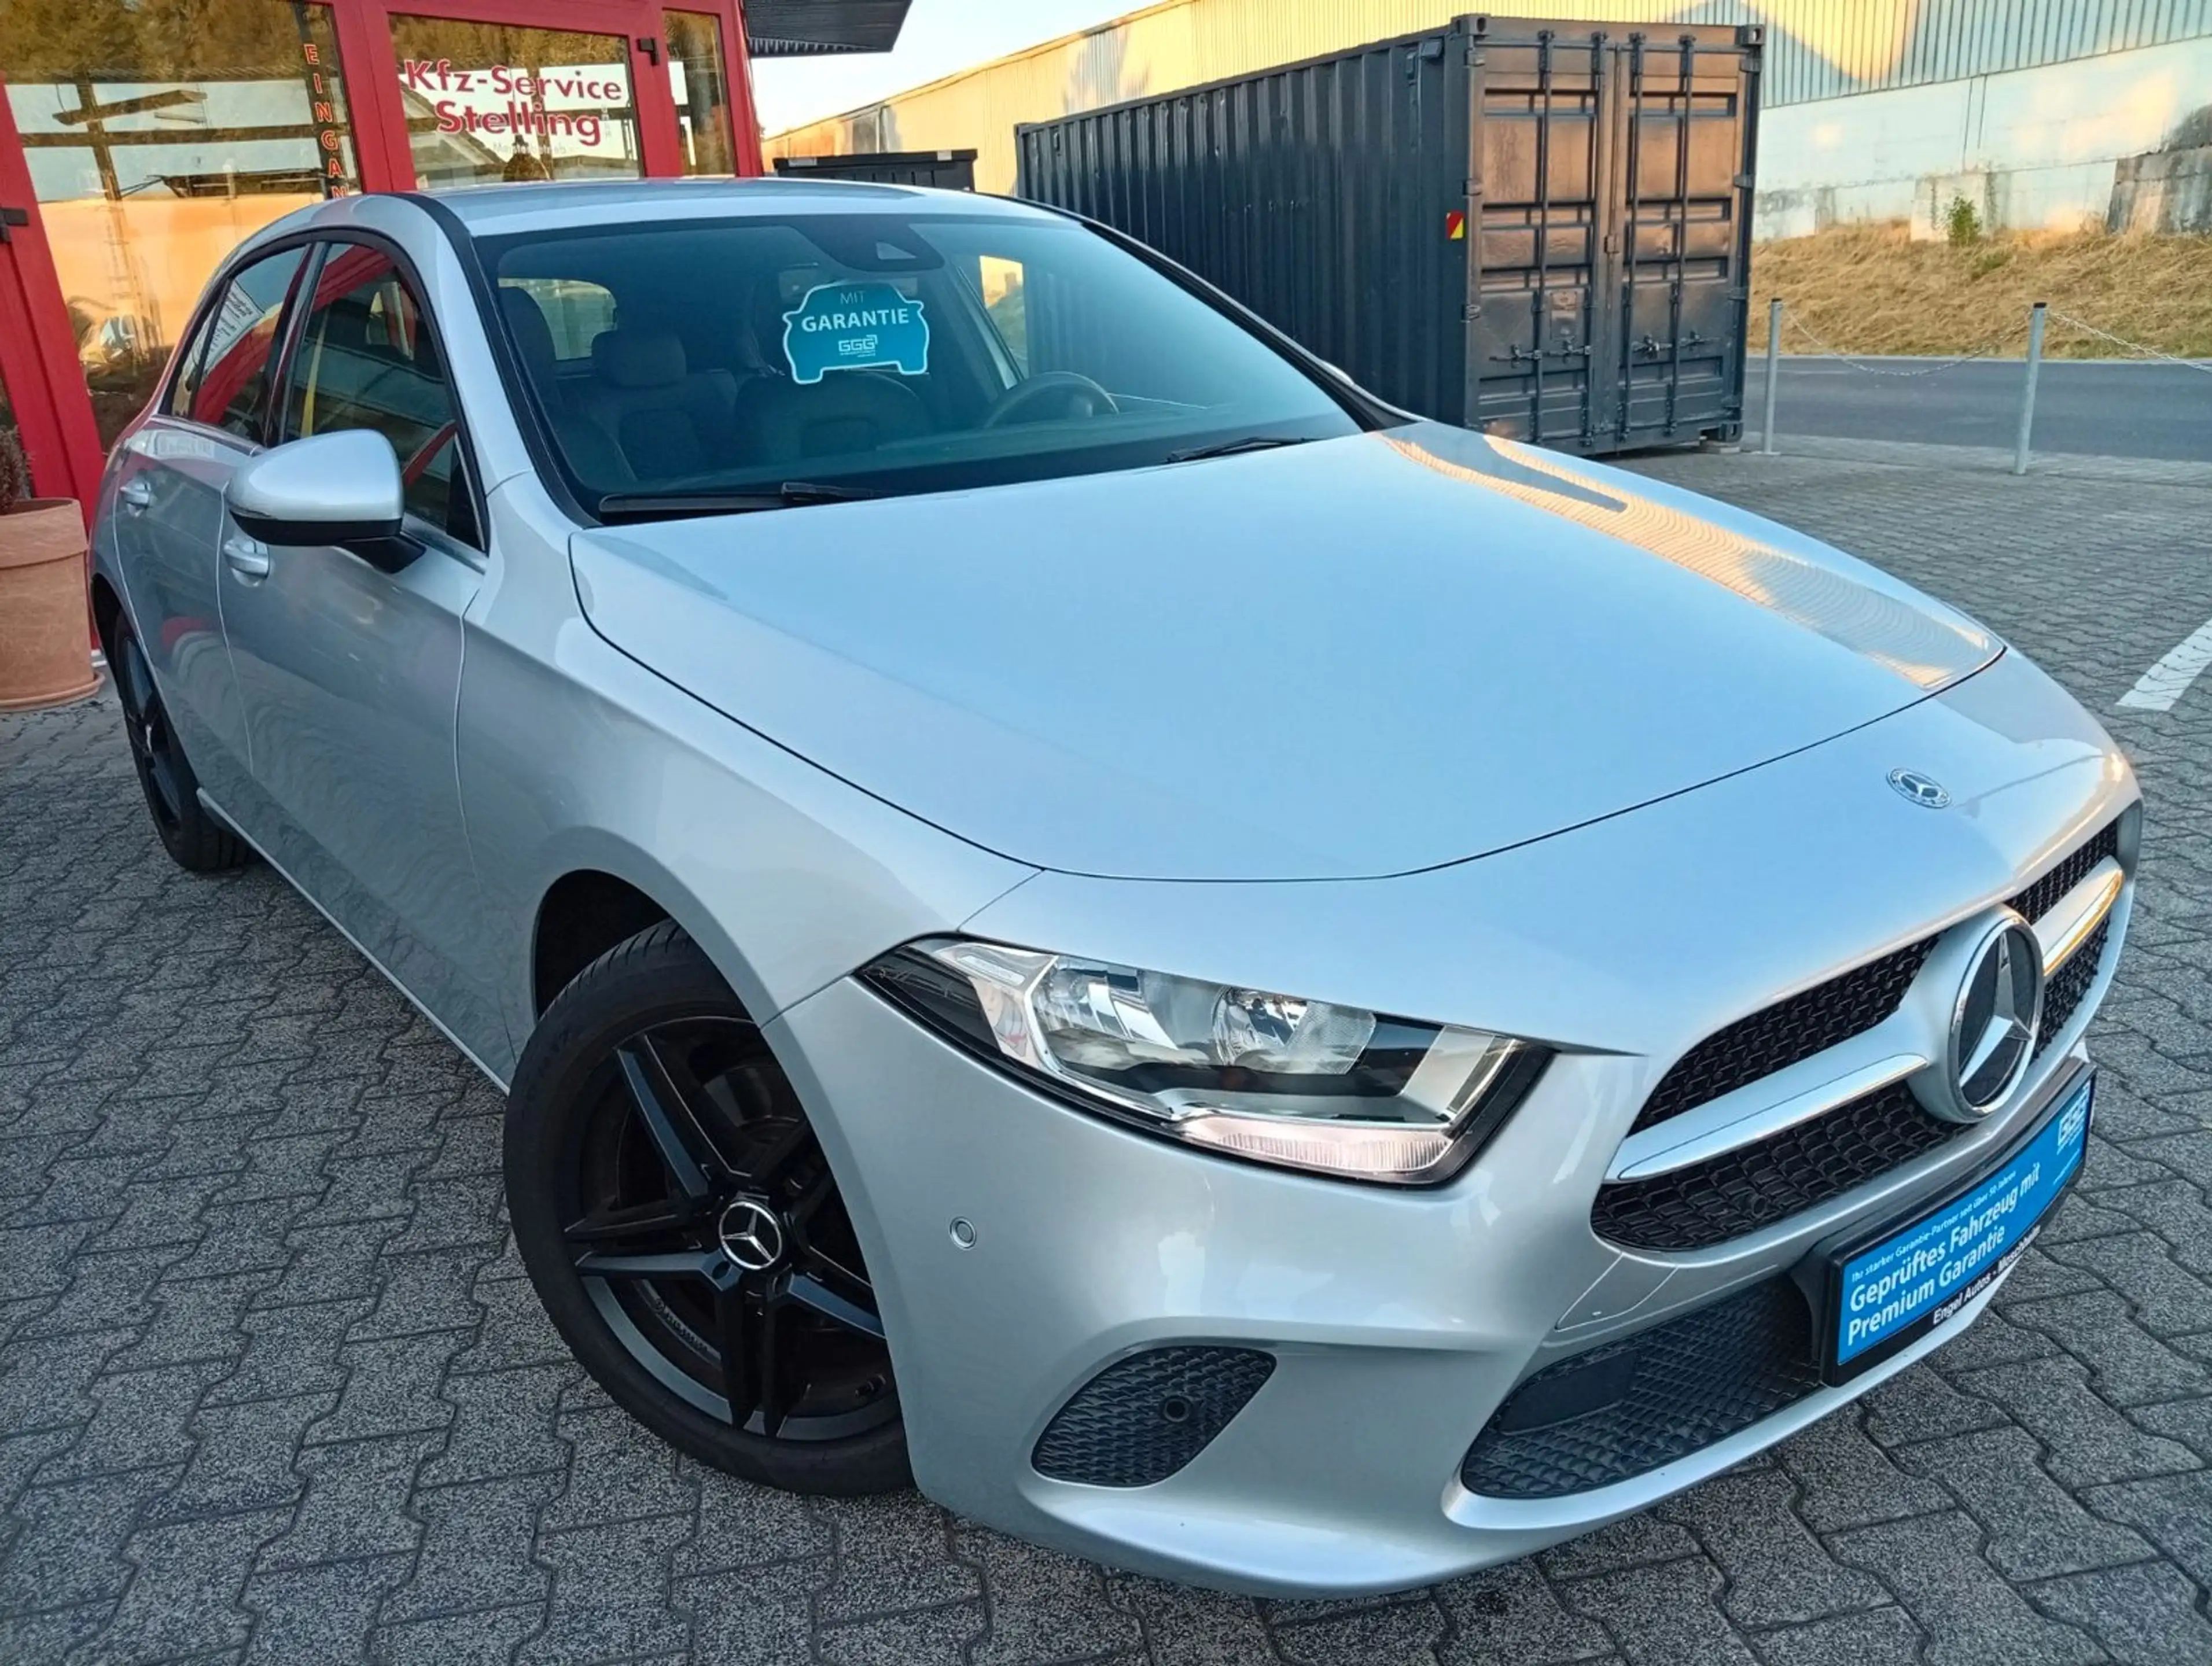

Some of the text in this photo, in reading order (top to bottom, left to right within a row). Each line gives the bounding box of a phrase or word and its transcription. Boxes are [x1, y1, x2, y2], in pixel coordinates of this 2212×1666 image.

[404, 58, 622, 101] Kfz-Service
[304, 43, 348, 198] EINGAN
[435, 99, 601, 146] Stelling
[801, 308, 909, 333] GARANTIE
[840, 290, 865, 305] MIT
[838, 334, 878, 352] GGG
[1850, 1241, 1946, 1313] Geprüftes
[1949, 1186, 2019, 1254] Fahrzeug
[2020, 1161, 2041, 1197] mit
[1852, 1270, 1864, 1282] Ihr
[1865, 1253, 1894, 1276] starker
[1895, 1214, 1959, 1258] Garantie-Partner
[1960, 1203, 1973, 1219] seit
[1973, 1193, 1988, 1209] über
[1847, 1225, 2005, 1346] Premium Garantie
[1933, 1292, 1963, 1325] Engel
[1963, 1273, 1991, 1302] Autos
